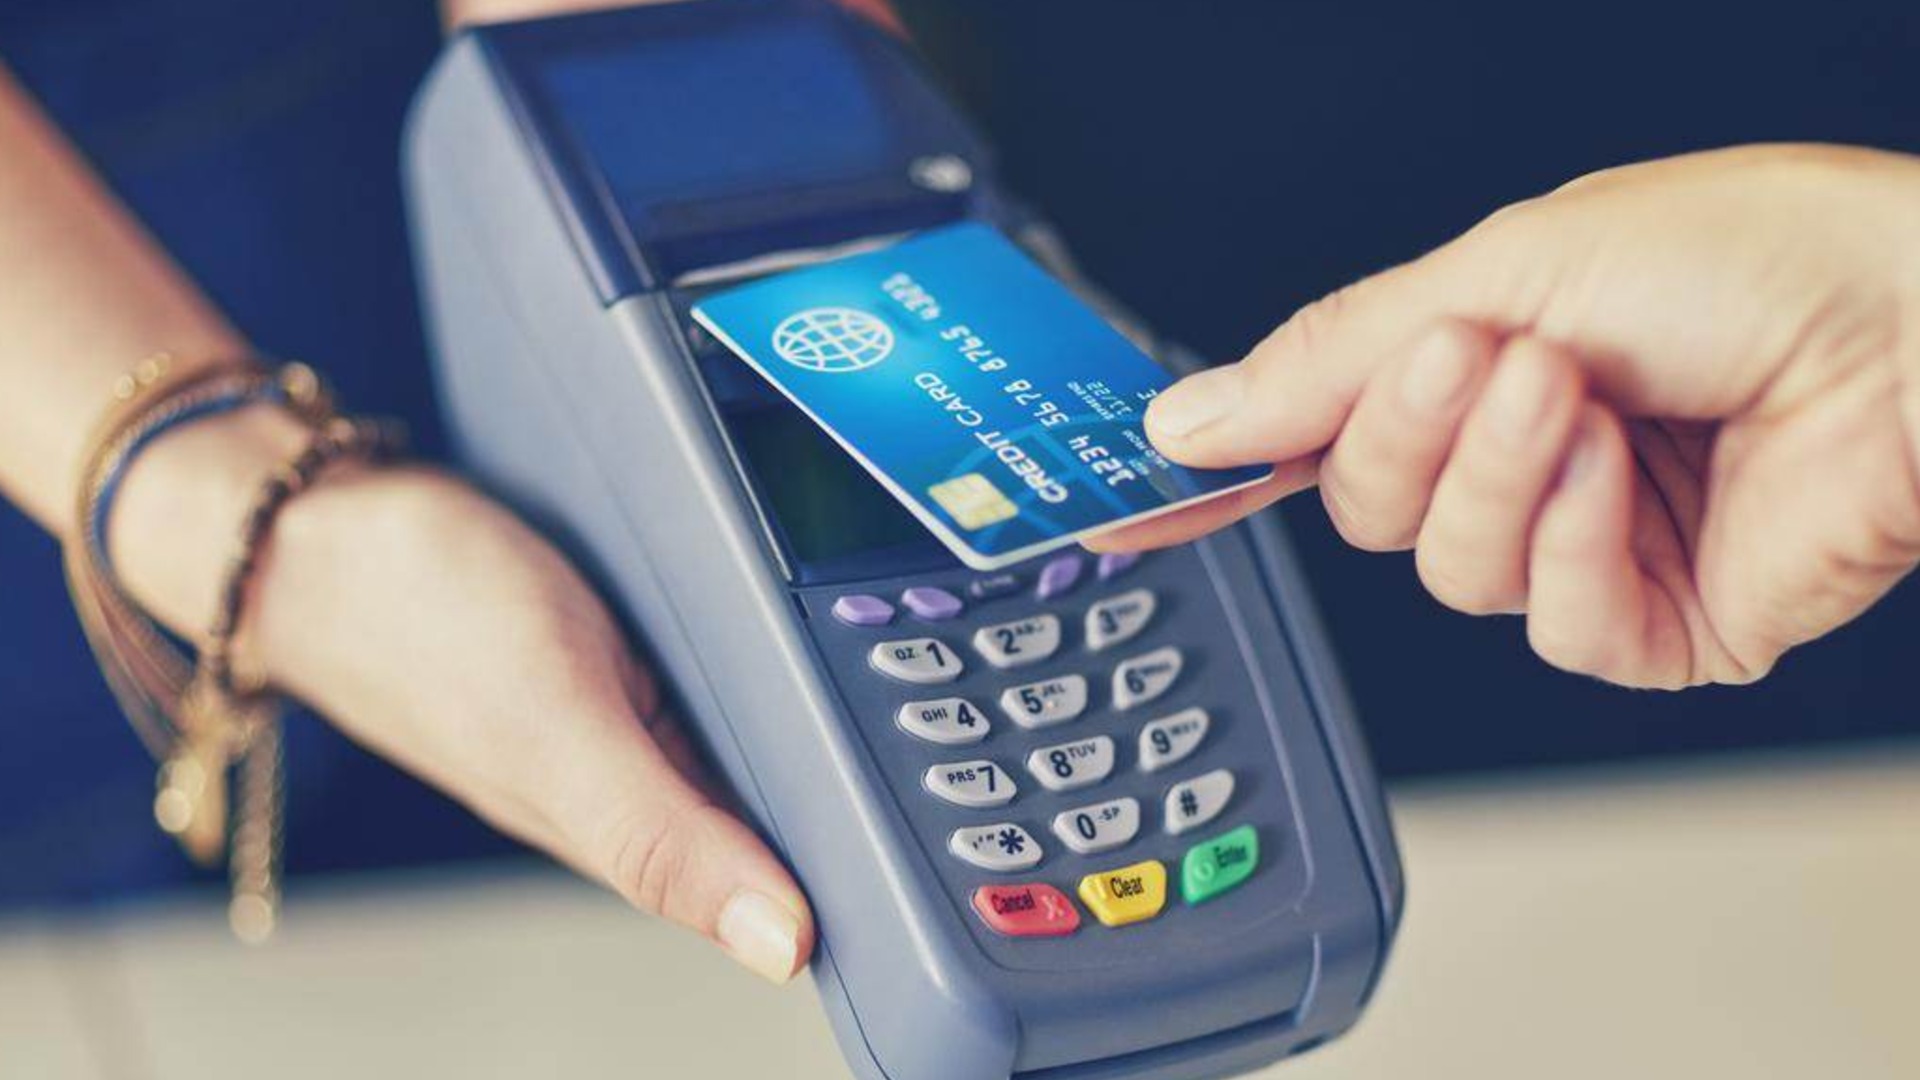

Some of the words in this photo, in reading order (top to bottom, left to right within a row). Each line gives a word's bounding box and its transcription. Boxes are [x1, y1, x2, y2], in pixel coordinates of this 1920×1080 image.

[940, 325, 1007, 372] 8765
[914, 372, 983, 427] CARD
[1004, 379, 1070, 427] 5678
[974, 430, 1069, 504] CREDIT
[1068, 434, 1136, 486] 1234
[1099, 609, 1118, 634] 3
[926, 642, 945, 667] 1
[997, 628, 1021, 654] 2
[1125, 667, 1145, 694] 6
[1021, 687, 1043, 714] 5
[922, 708, 948, 722] GHI
[957, 703, 976, 727] 4
[1151, 728, 1171, 754] 9
[1050, 750, 1073, 777] 8
[1067, 743, 1097, 758] TUV
[947, 769, 976, 784] PRS
[977, 765, 996, 792] 7
[1077, 813, 1096, 840] 0
[1110, 875, 1145, 899] Clear
[991, 889, 1036, 915] Cancel
